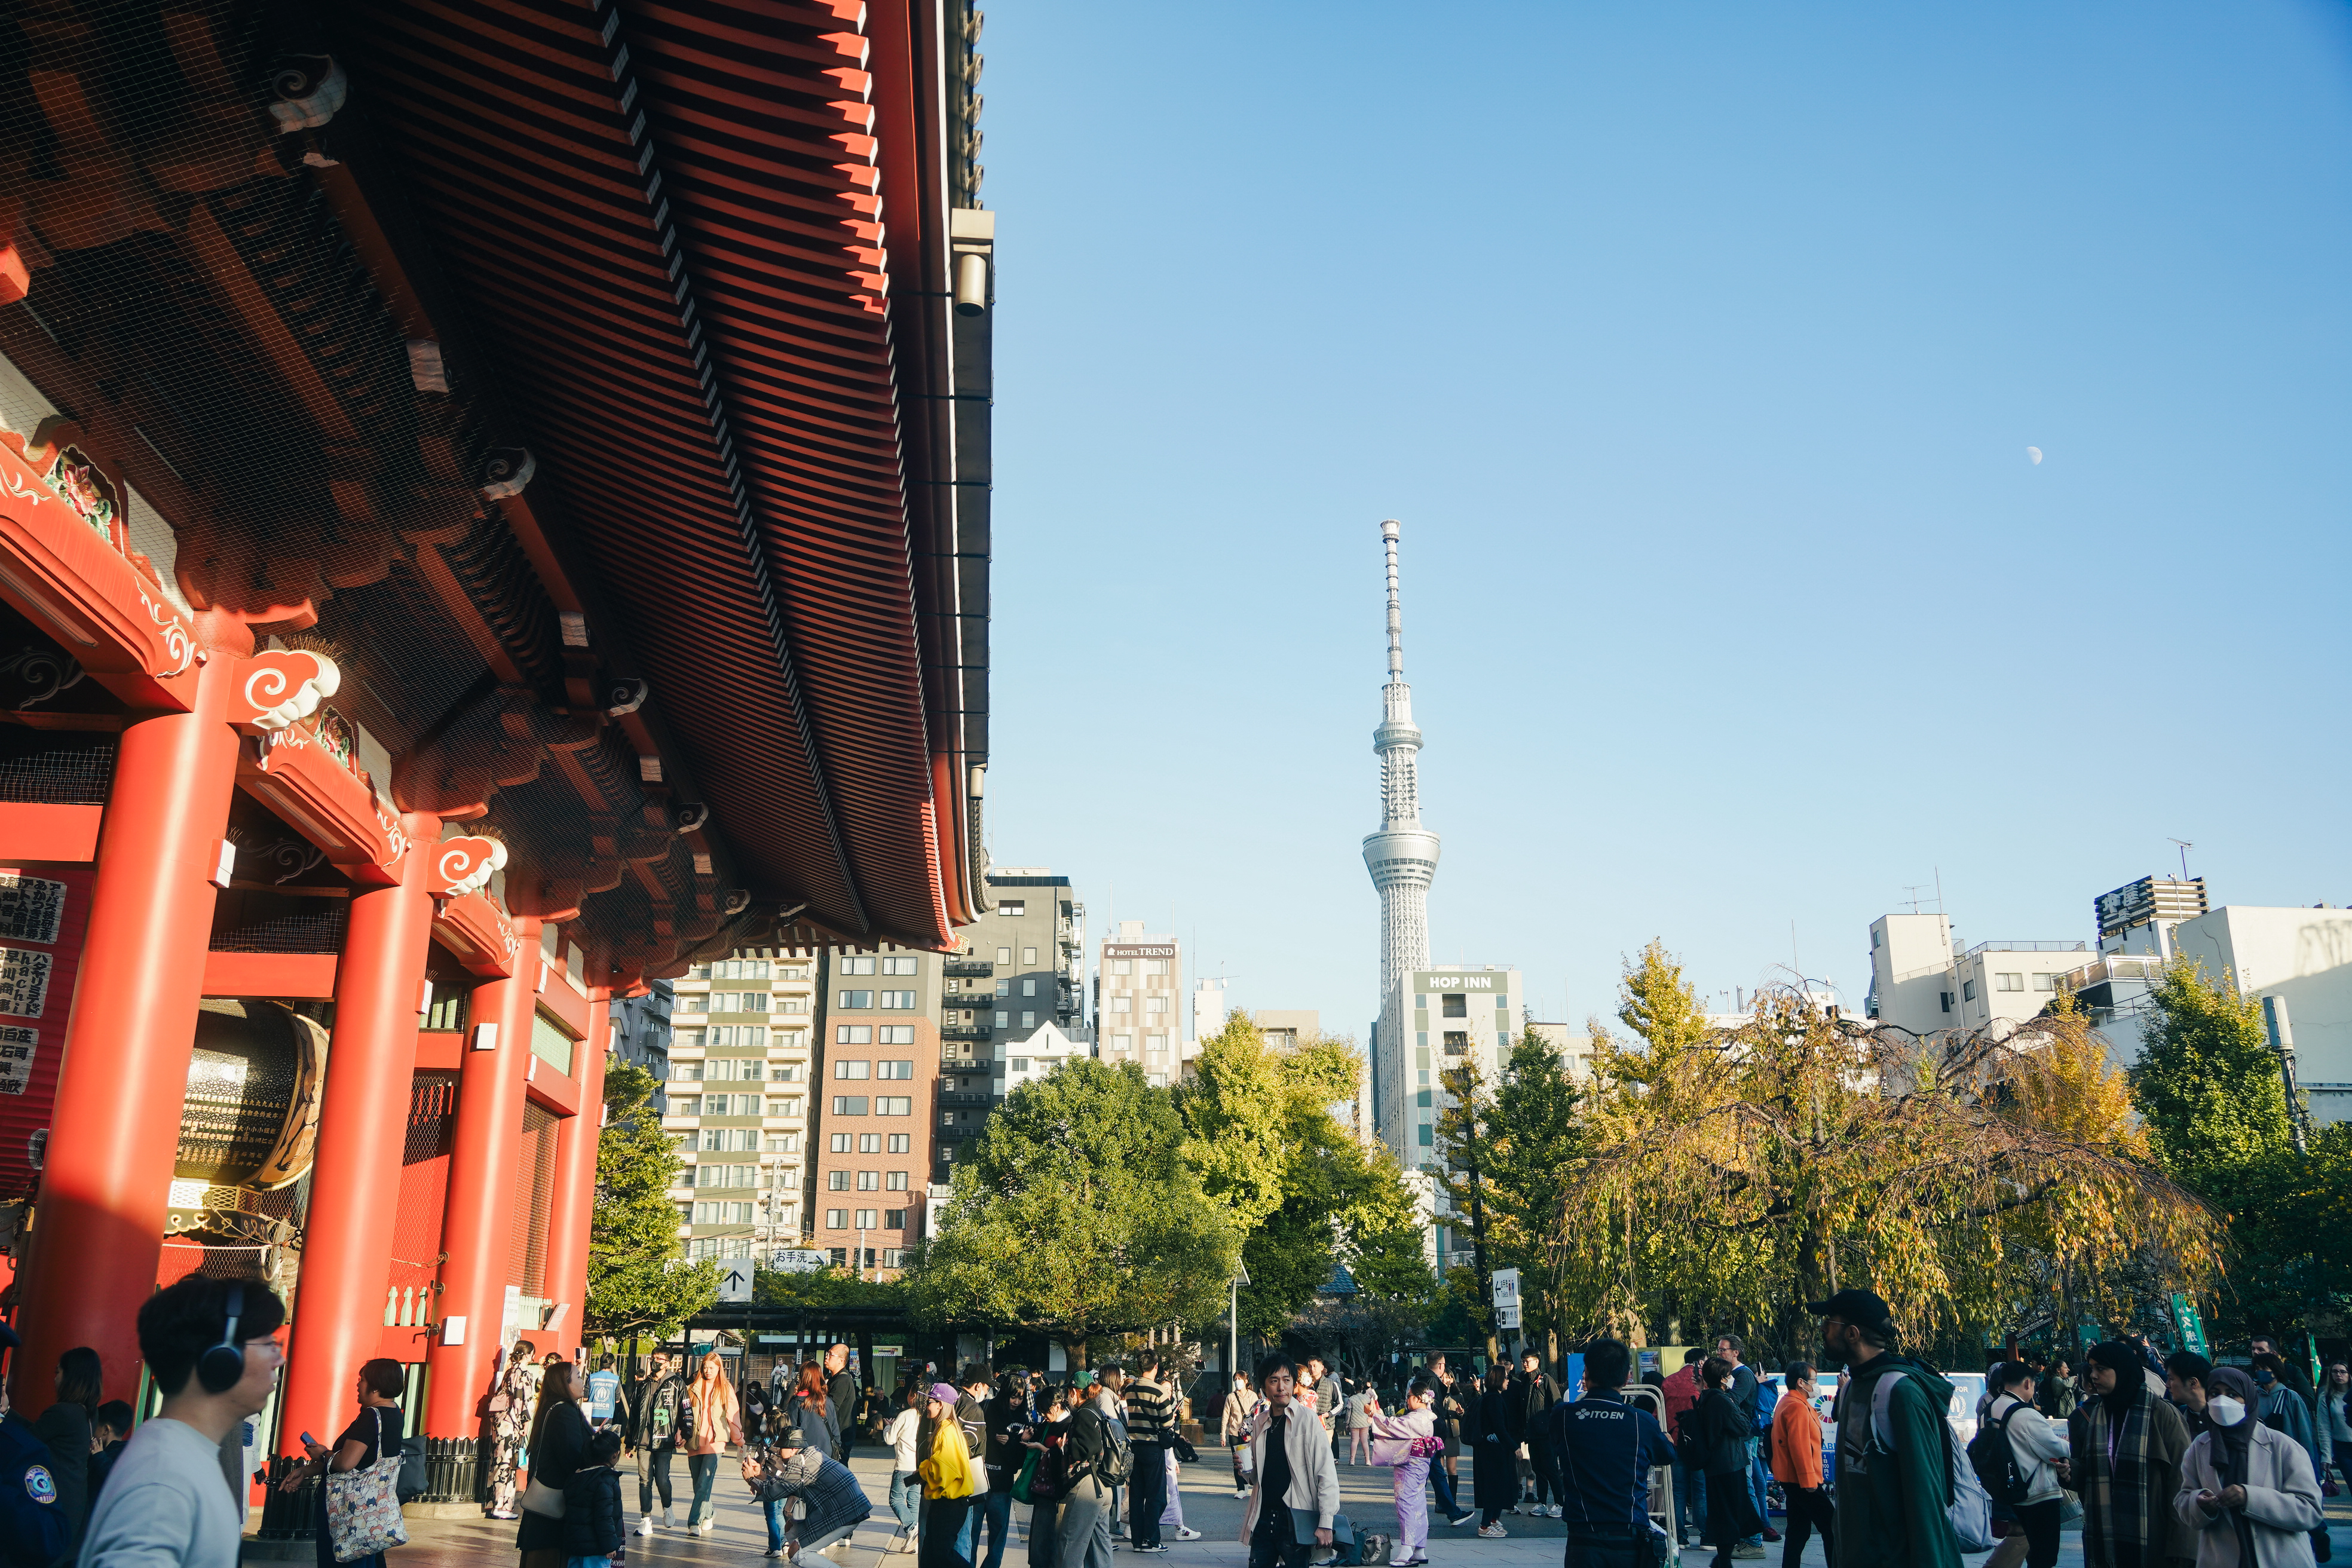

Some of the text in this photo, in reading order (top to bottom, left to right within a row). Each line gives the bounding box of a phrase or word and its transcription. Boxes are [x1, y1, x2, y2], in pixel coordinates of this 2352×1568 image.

[13, 952, 31, 1014] hachi
[25, 954, 48, 1015] ハタヤリミテッド
[1429, 977, 1492, 988] HOP INN
[776, 1251, 807, 1263] お手洗
